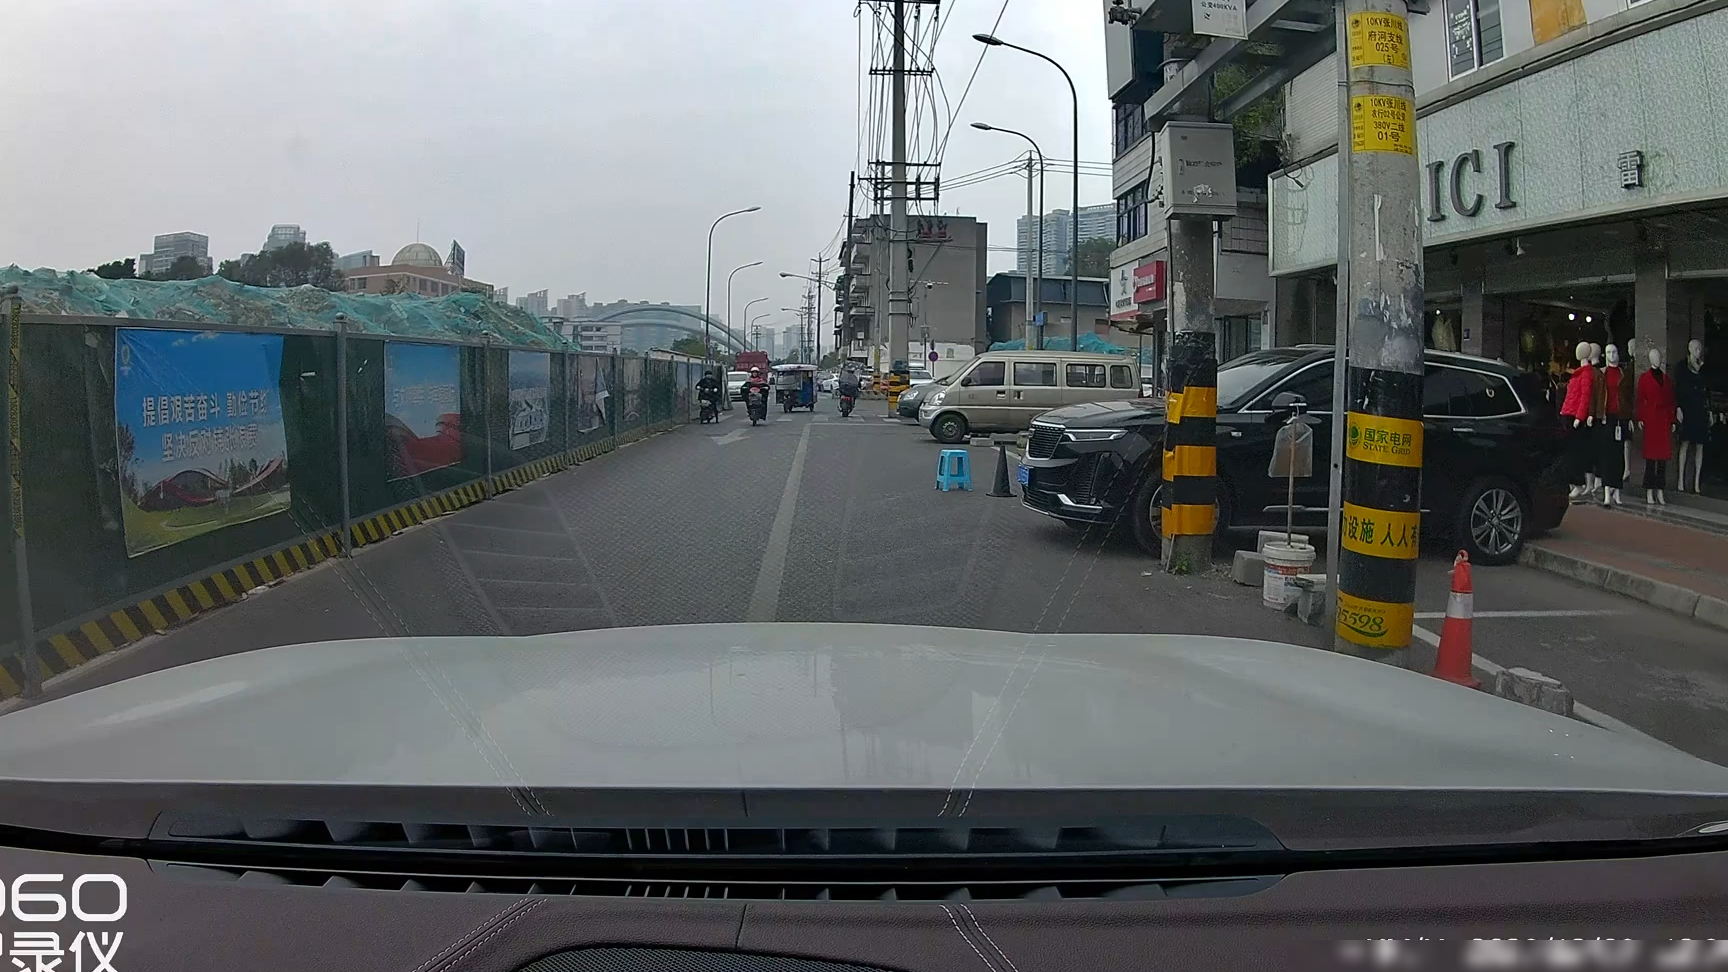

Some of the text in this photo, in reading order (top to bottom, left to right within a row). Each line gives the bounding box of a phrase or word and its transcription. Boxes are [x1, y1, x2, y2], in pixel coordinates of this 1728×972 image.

[1375, 42, 1399, 54] 025号
[1377, 131, 1400, 142] 01号
[1617, 150, 1644, 190] 雷
[142, 391, 220, 427] 提倡艰苦奋斗
[1364, 427, 1412, 447] 国家电网
